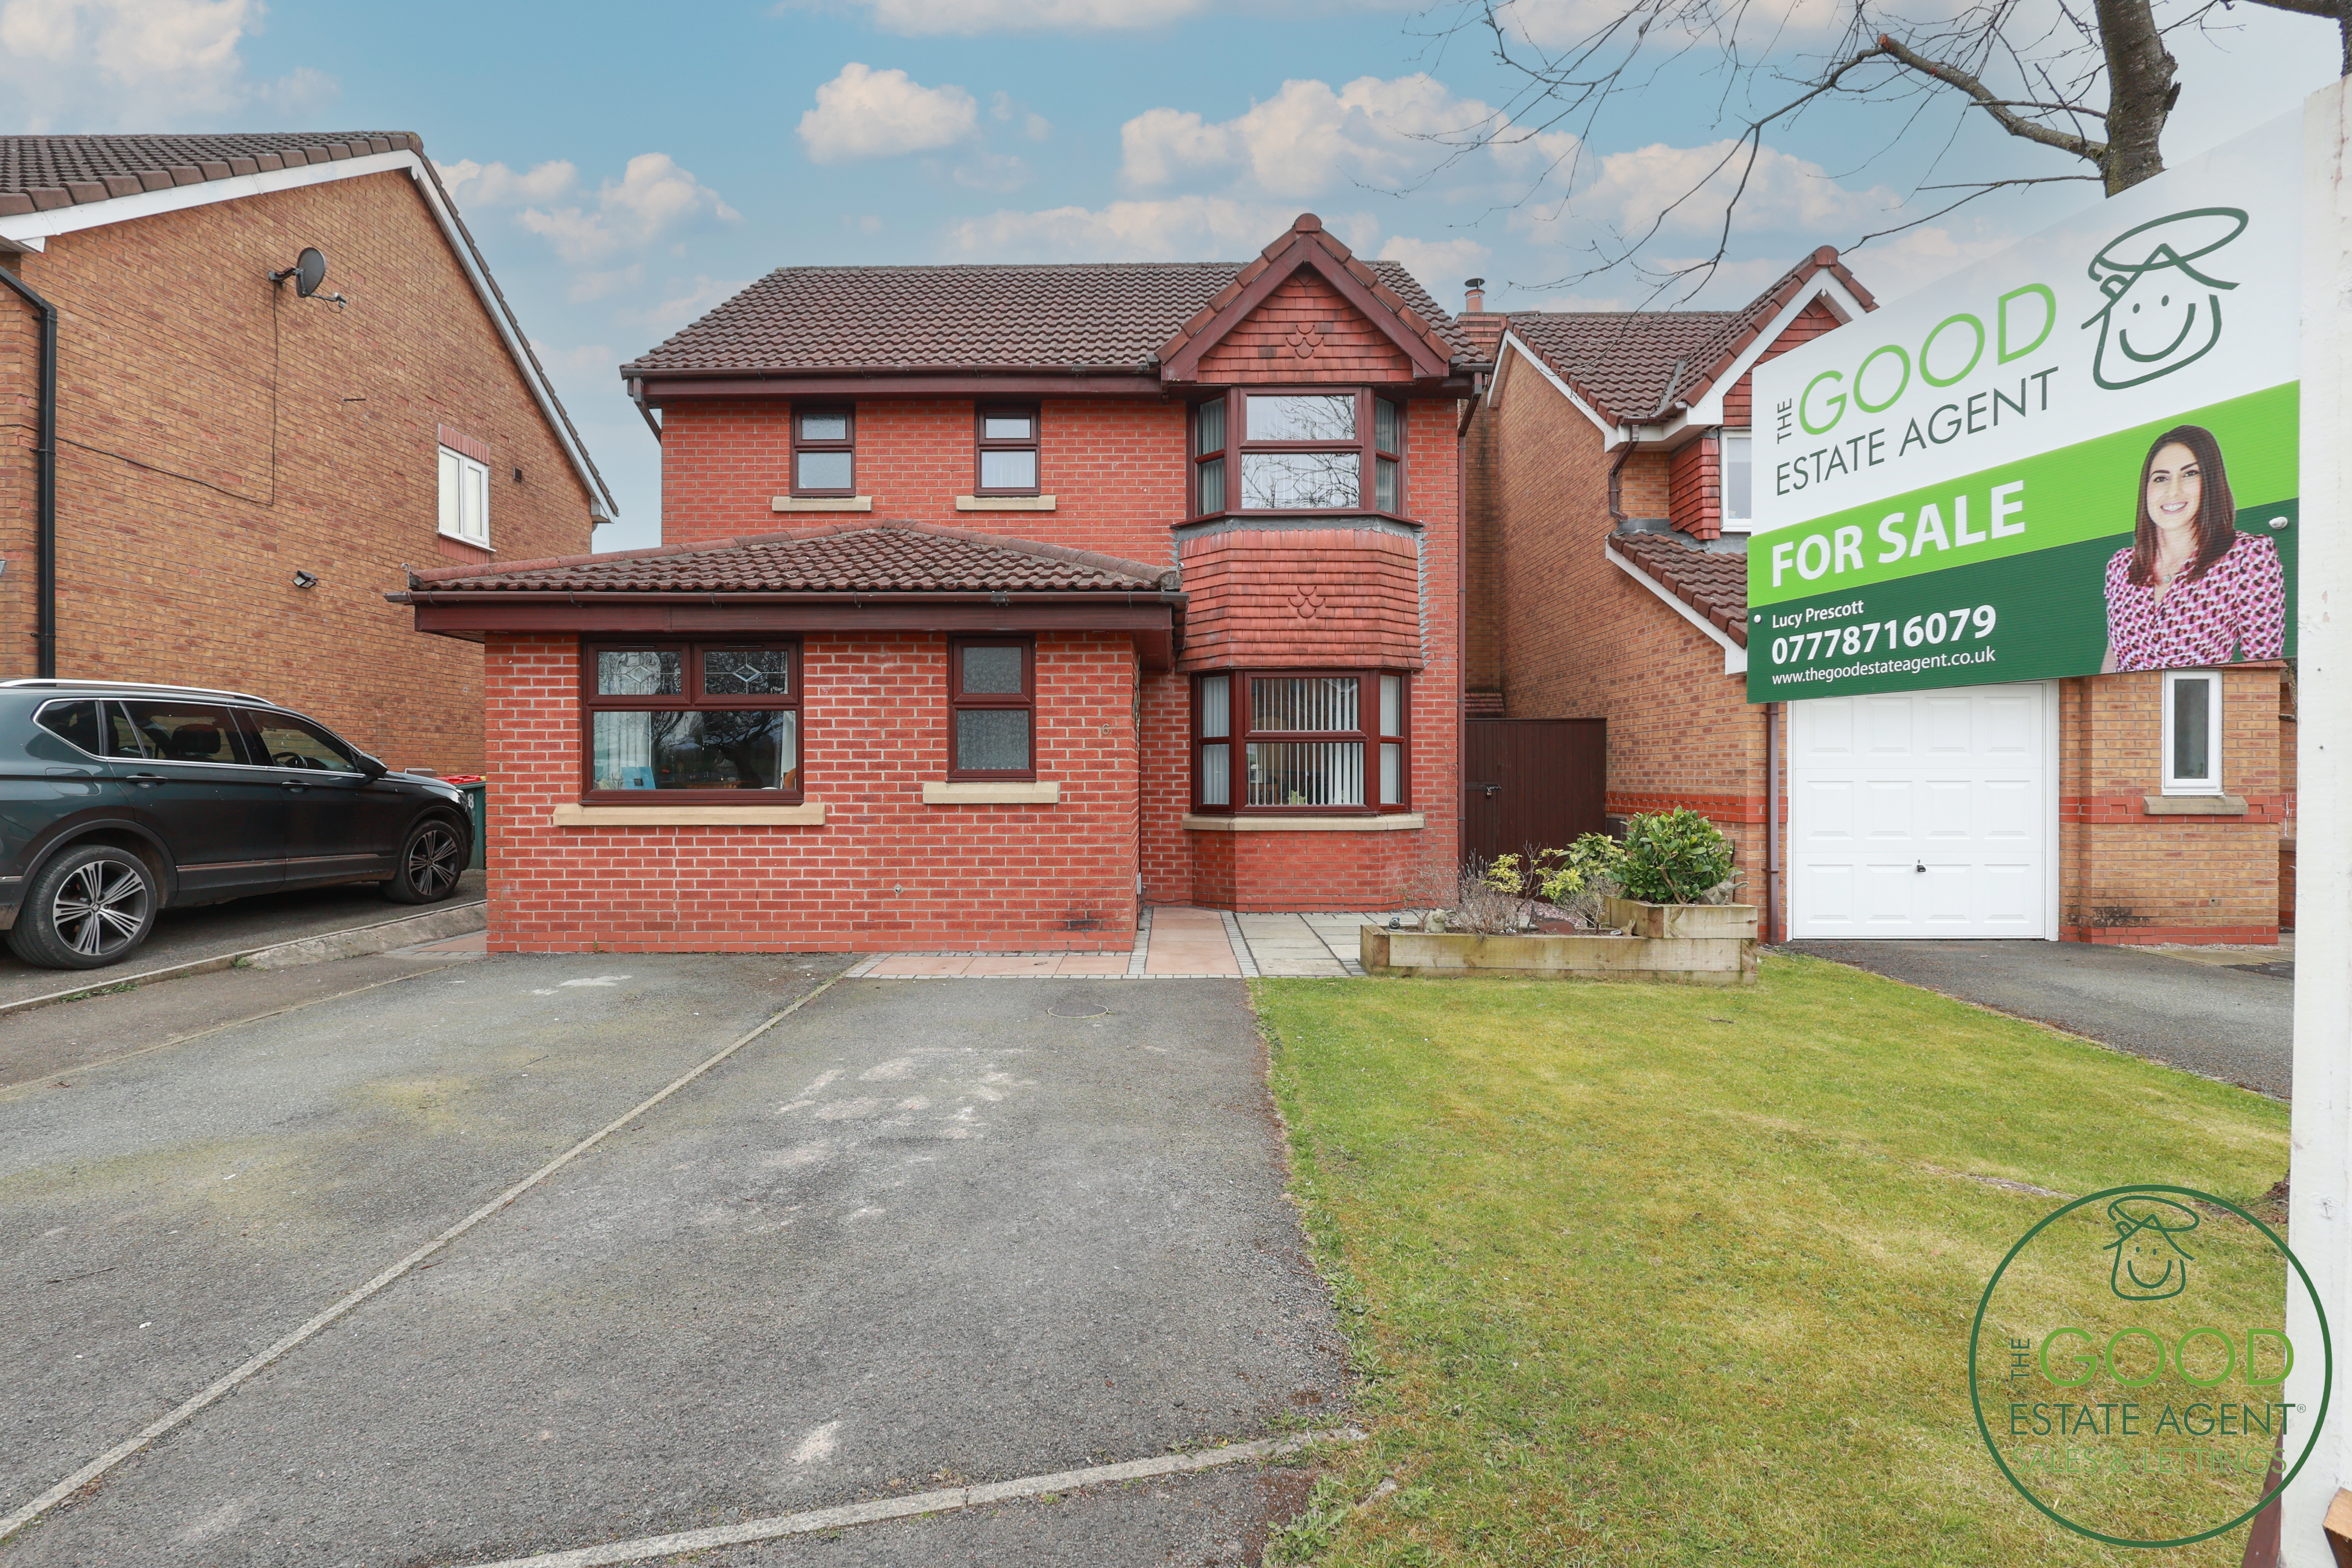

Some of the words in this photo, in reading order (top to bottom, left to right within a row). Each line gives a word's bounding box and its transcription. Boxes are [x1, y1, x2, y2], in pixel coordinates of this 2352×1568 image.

[1799, 283, 2056, 435] GOOD
[1777, 398, 1792, 444] THE
[1777, 428, 1885, 496] ESTATE
[1899, 366, 2059, 457] AGENT
[1772, 525, 1864, 588] FOR
[1878, 480, 2026, 564] SALE
[1771, 604, 1997, 665] 07778716079
[1772, 612, 1803, 628] Lucy
[1805, 600, 1864, 622] Prescott
[1772, 645, 1997, 685] www.thegoodestateagent.co.uk
